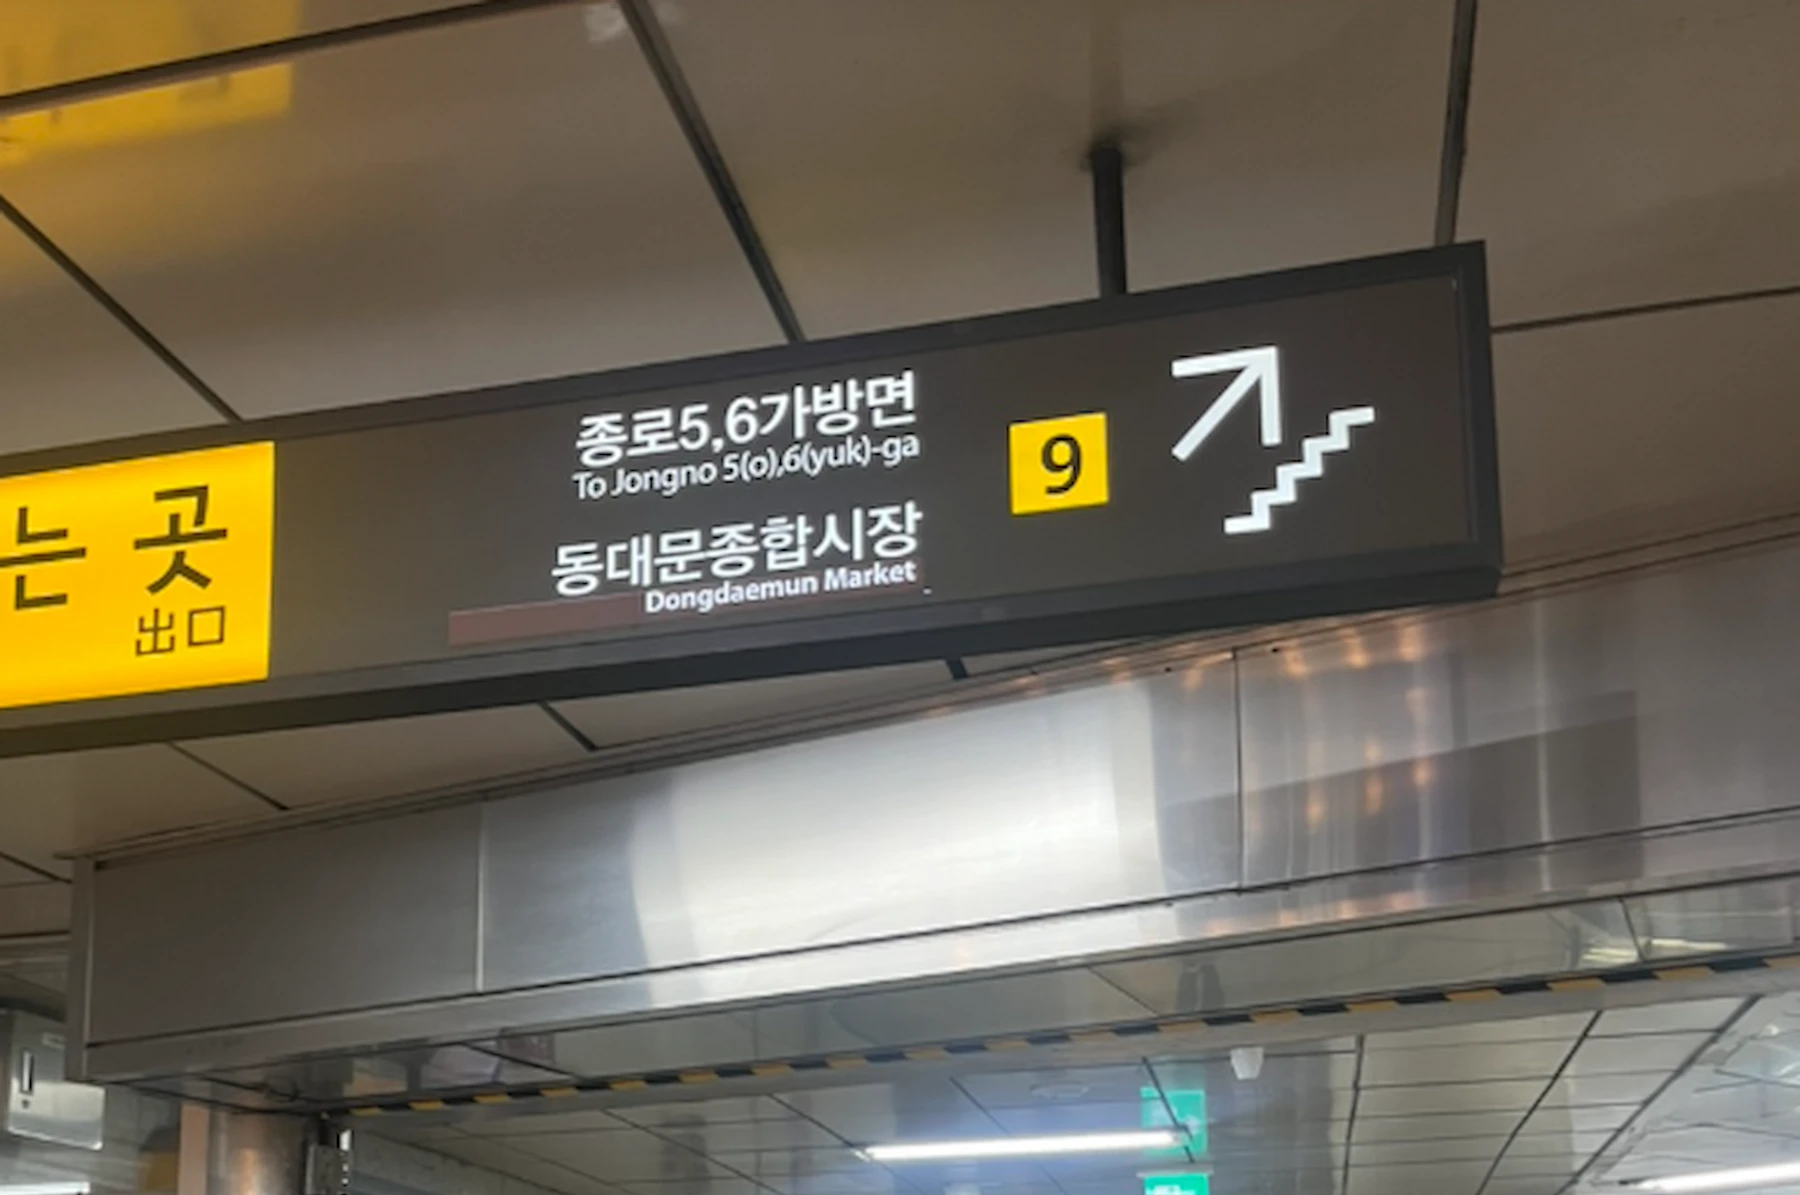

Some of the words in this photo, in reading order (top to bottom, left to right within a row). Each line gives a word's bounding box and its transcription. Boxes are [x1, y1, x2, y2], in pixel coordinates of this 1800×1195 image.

[575, 370, 917, 468] 종로5,6가방면
[572, 472, 607, 500] To
[611, 461, 717, 497] Jongno
[723, 434, 920, 482] 5(o),6(yuk)-ga
[1041, 433, 1083, 496] 9
[0, 506, 87, 610] 는
[134, 485, 228, 595] 곳
[551, 500, 924, 597] 동대문종합시장
[645, 571, 818, 614] Dongdaemun
[824, 560, 917, 592] Market
[135, 605, 226, 657] 出口
